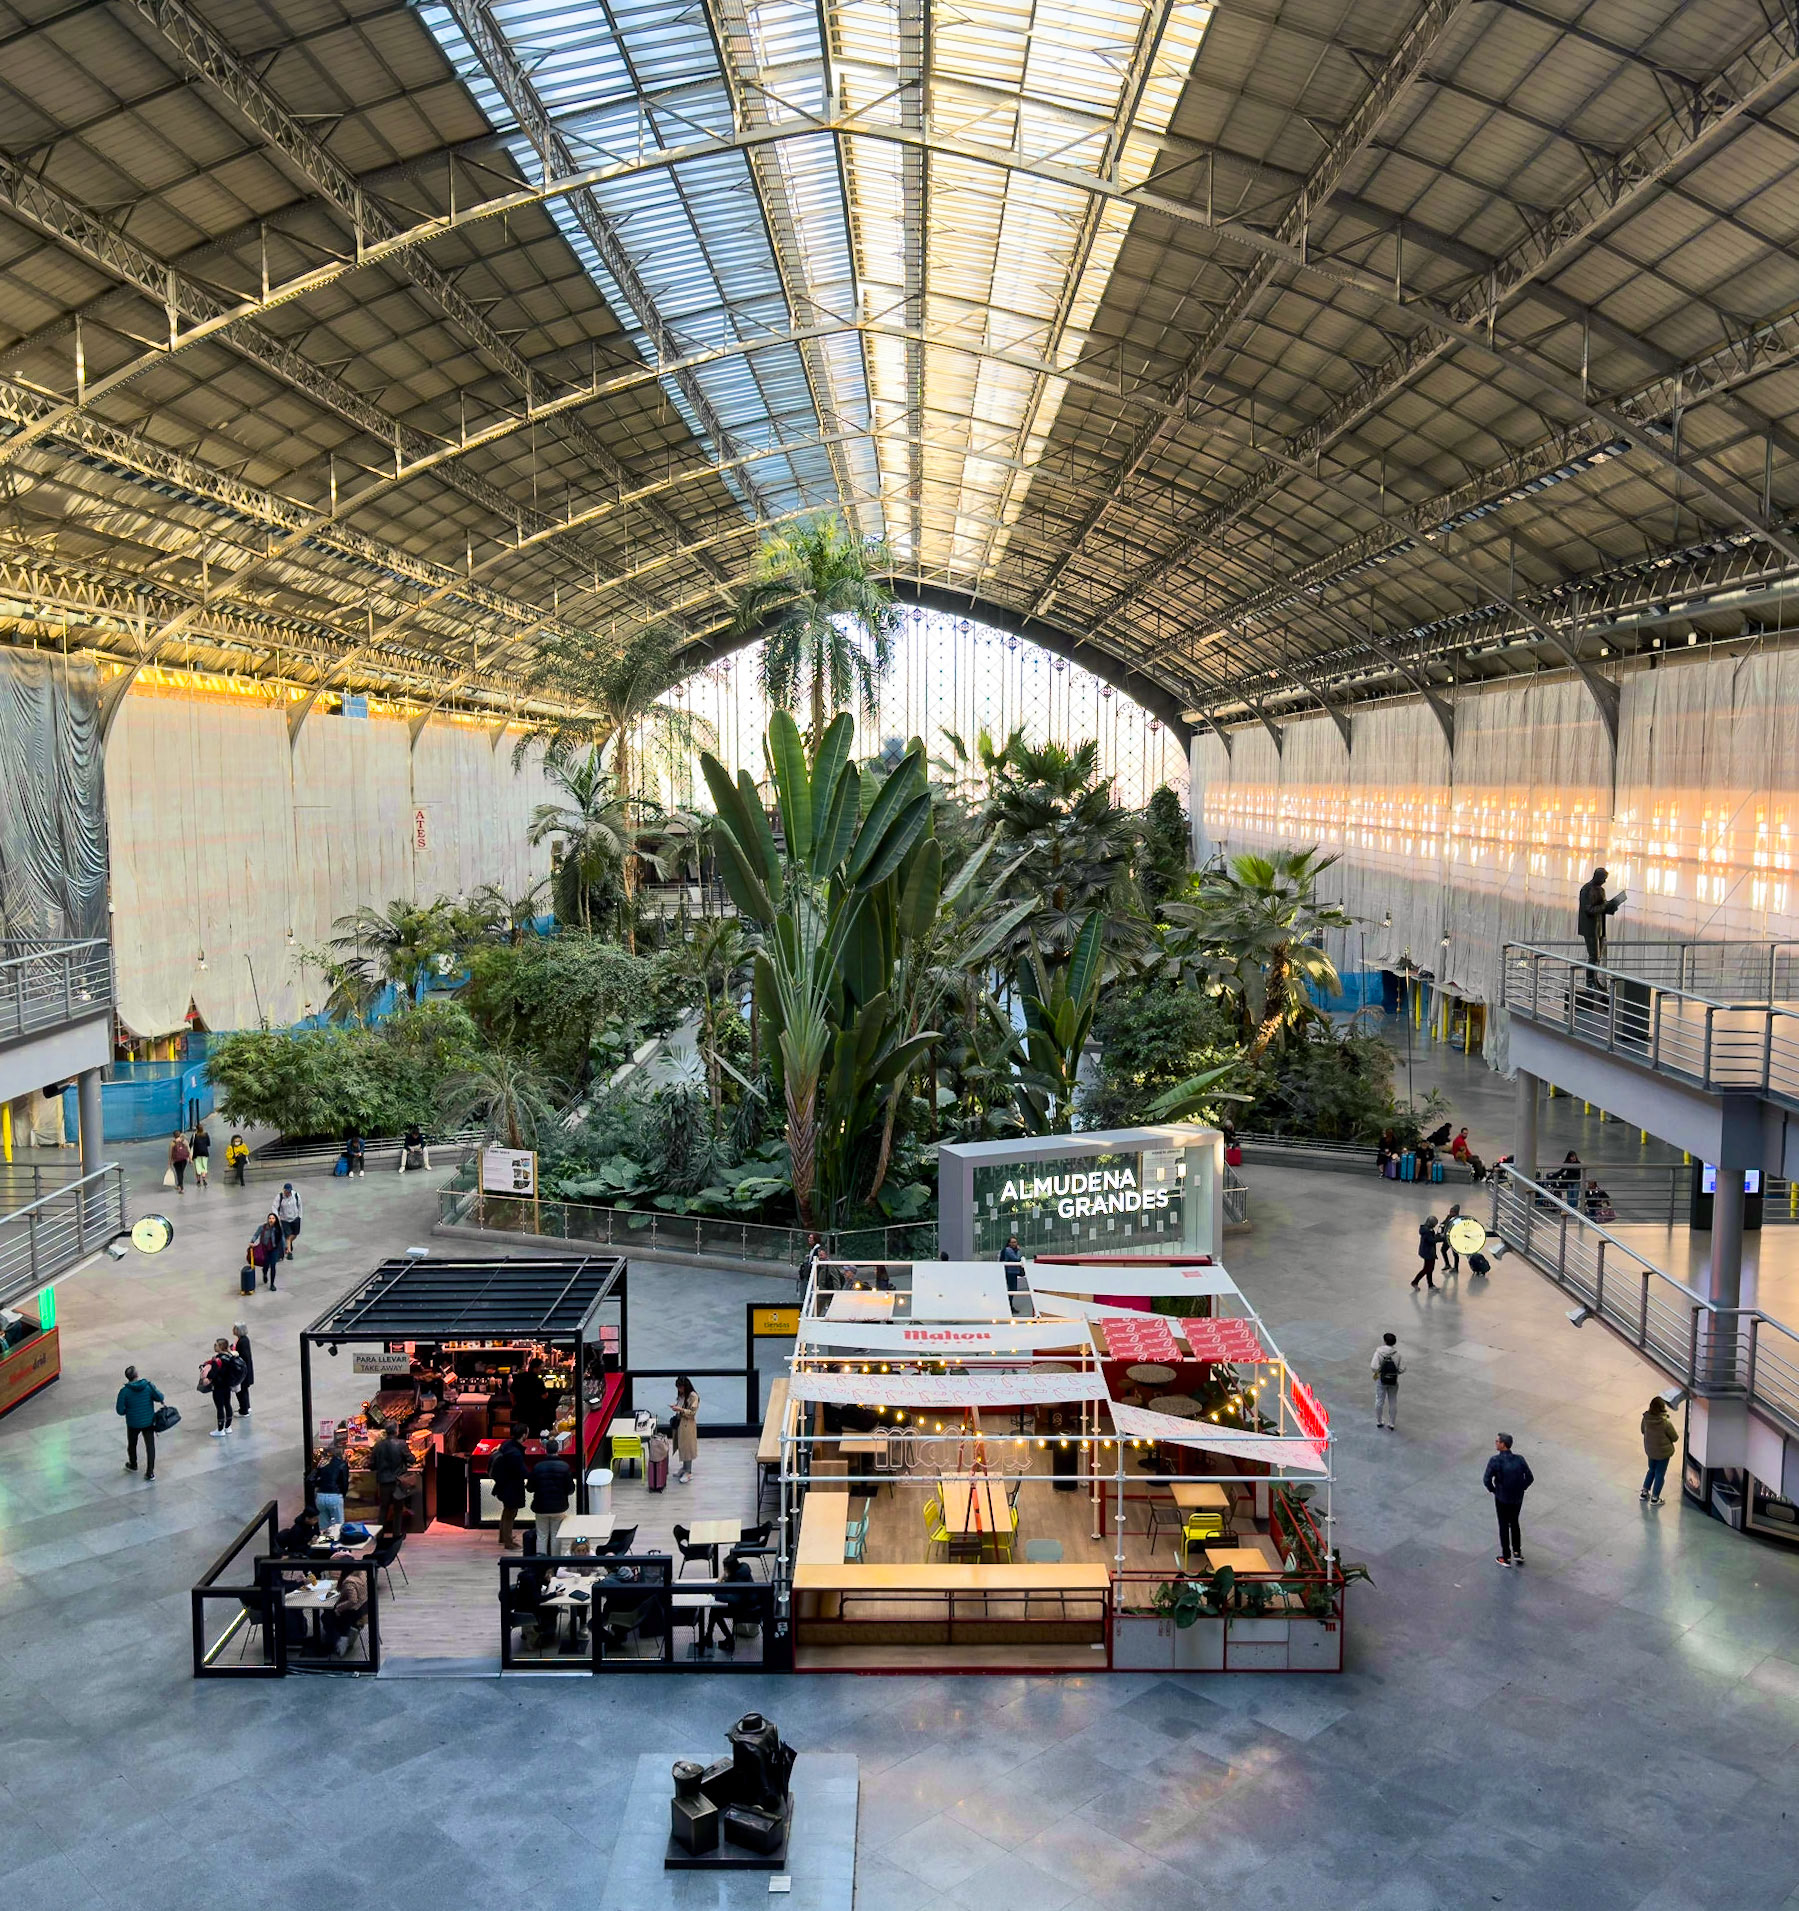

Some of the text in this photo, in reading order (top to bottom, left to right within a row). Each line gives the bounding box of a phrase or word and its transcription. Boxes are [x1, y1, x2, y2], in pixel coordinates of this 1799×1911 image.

[1000, 1168, 1137, 1202] ALMUDENA
[1058, 1188, 1169, 1219] GRANDES
[360, 1364, 403, 1372] TAKE AWAY
